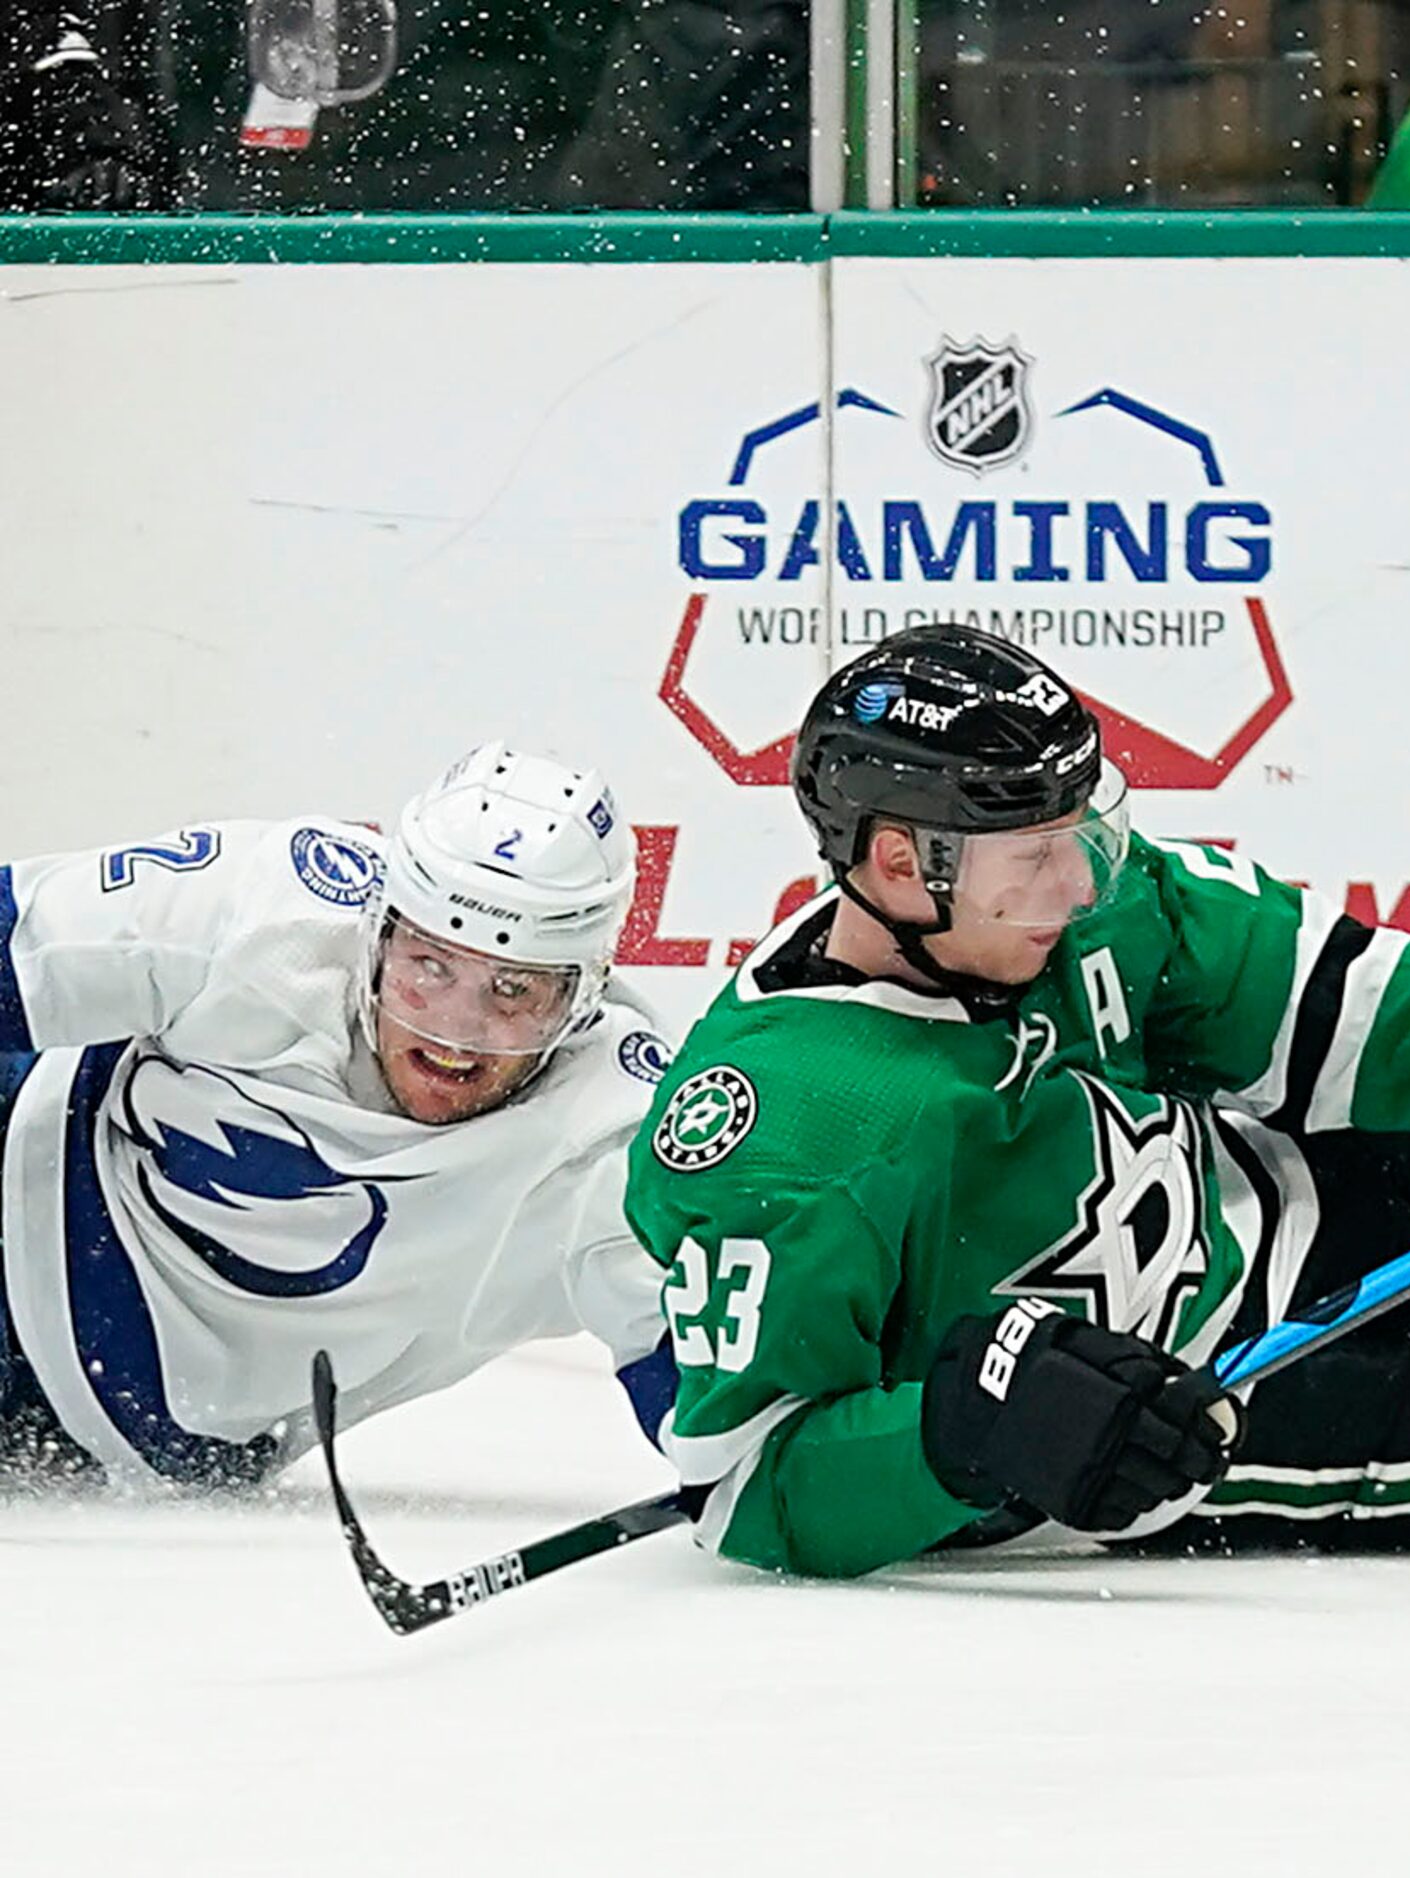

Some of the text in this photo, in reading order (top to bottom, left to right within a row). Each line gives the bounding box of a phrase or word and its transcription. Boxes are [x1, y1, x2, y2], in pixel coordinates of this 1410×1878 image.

[946, 372, 1013, 446] NHL
[678, 500, 1274, 582] GAMING
[888, 696, 958, 732] AT&T
[102, 828, 222, 893] 2
[493, 828, 523, 861] 2
[448, 893, 523, 923] BAUER
[1080, 946, 1132, 1060] A
[659, 1131, 736, 1164] STARS
[663, 1236, 771, 1372] 23
[978, 1296, 1067, 1402] BAU
